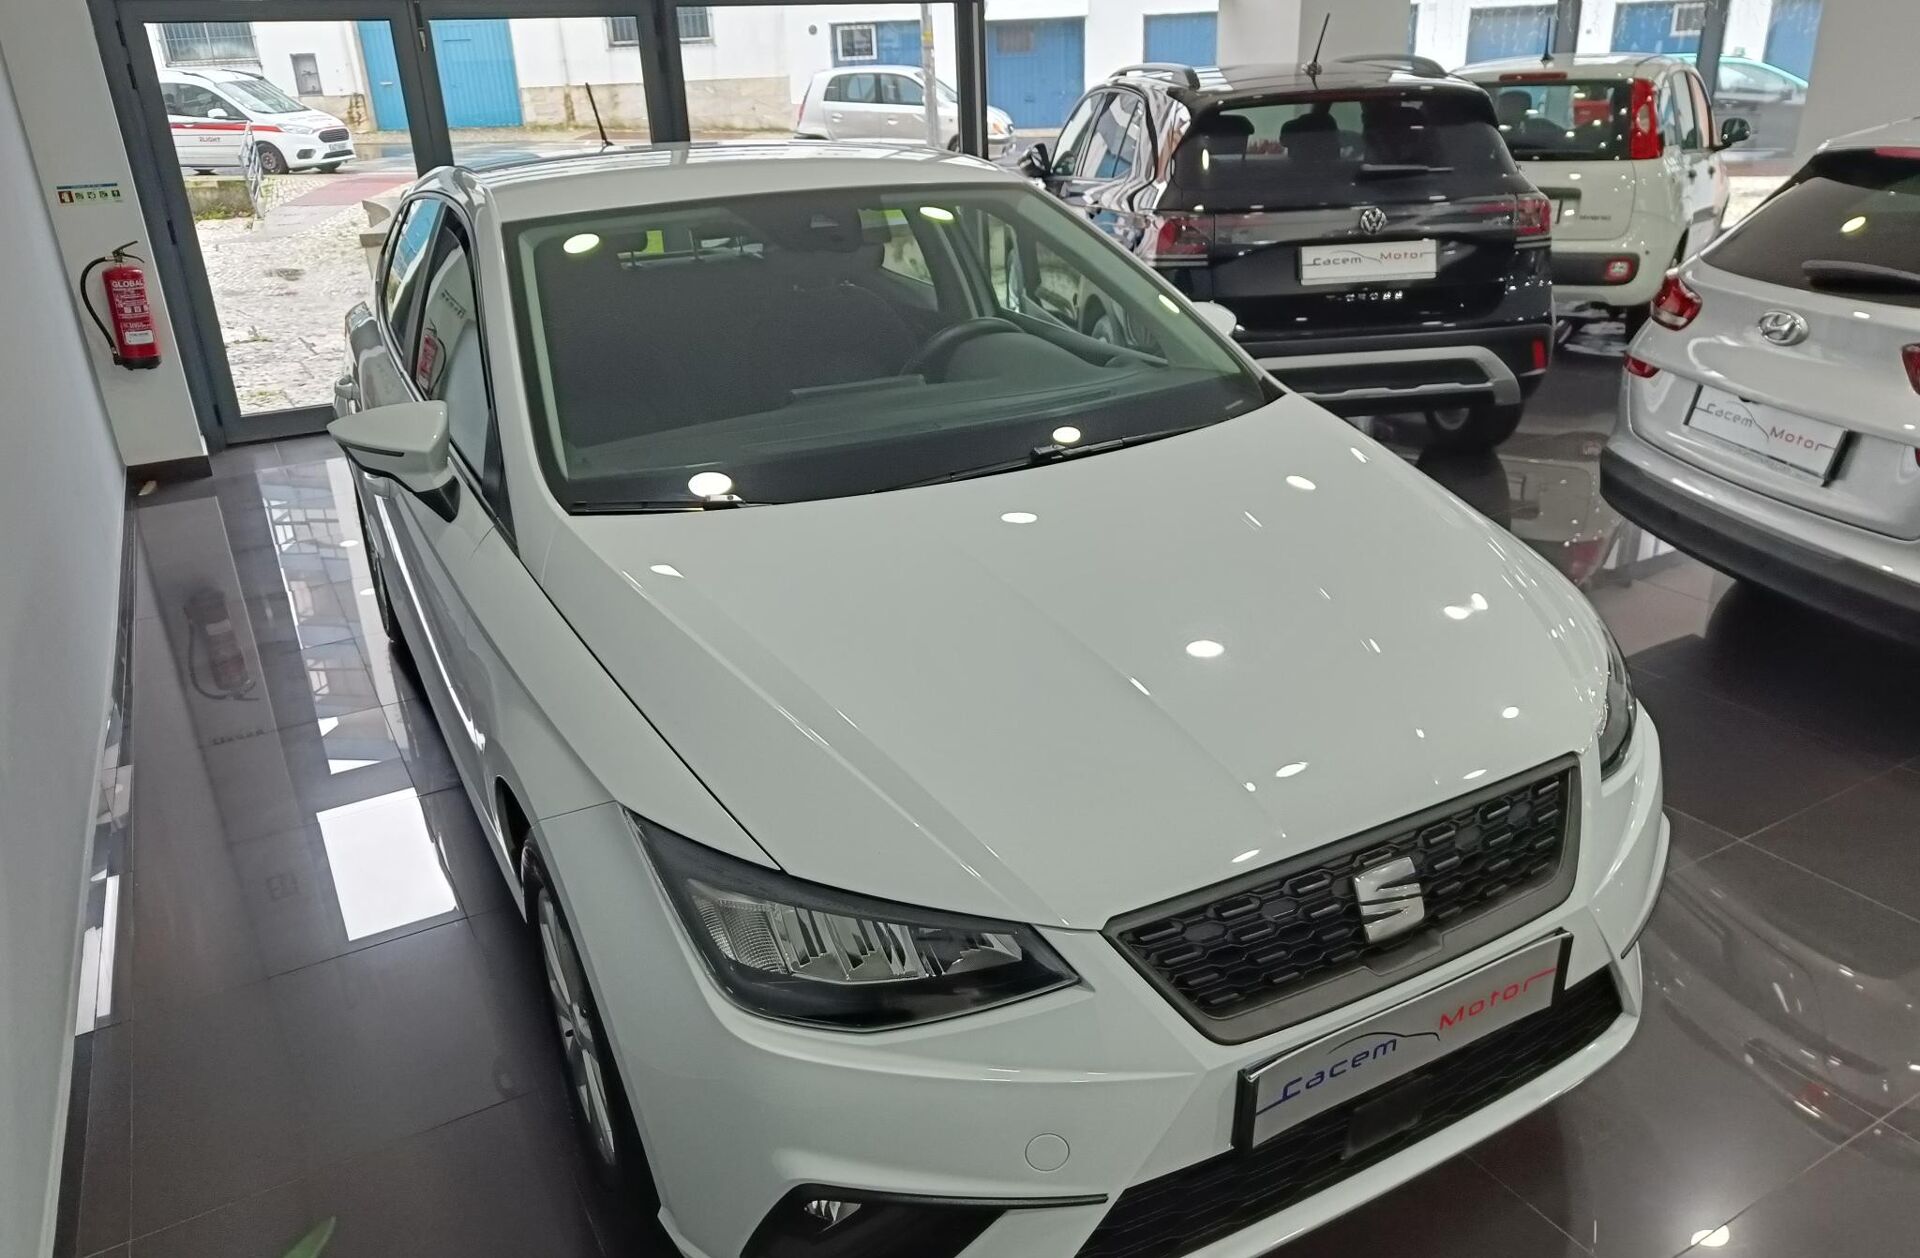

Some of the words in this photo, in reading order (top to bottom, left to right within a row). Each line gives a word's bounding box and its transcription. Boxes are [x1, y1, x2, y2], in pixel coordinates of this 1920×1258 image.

[1312, 256, 1362, 267] Cacem
[1380, 250, 1432, 261] Motor
[111, 280, 144, 288] GLOBAL
[1705, 402, 1754, 428] Cacem
[1769, 425, 1832, 452] Motor
[1279, 1037, 1398, 1102] Cacem
[1438, 967, 1554, 1032] Motor
